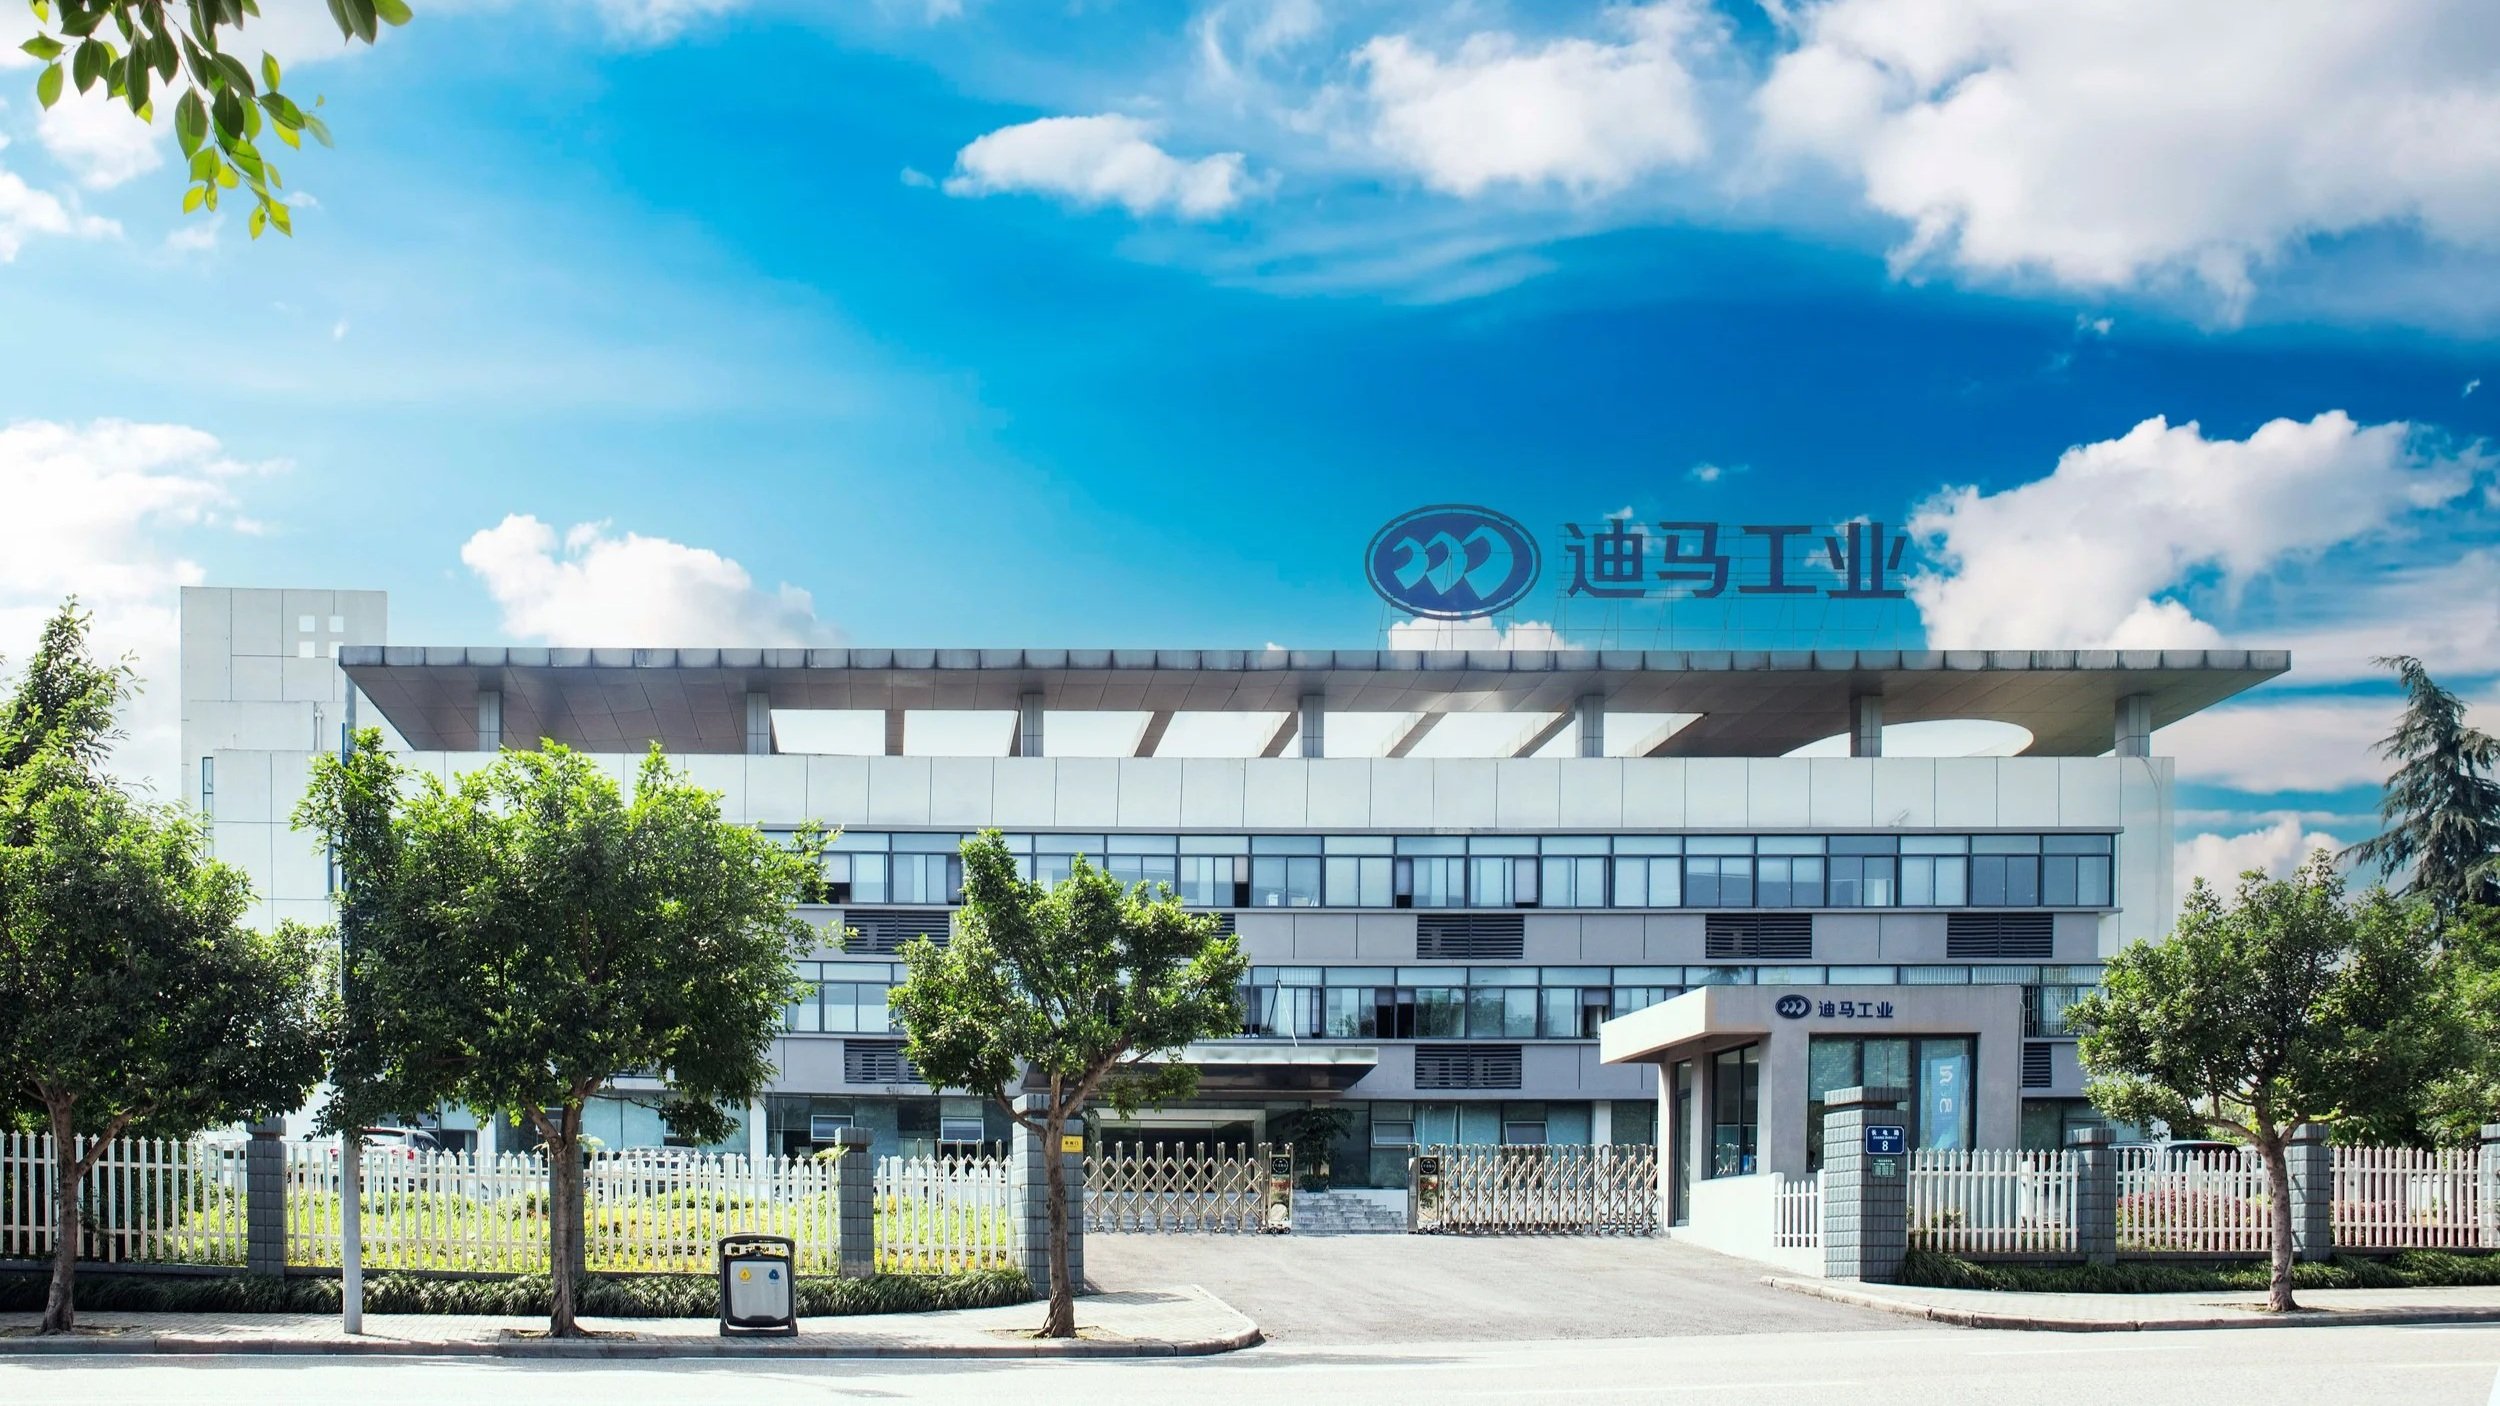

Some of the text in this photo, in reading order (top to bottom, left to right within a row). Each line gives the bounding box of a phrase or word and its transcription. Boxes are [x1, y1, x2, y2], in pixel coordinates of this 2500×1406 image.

[1565, 518, 1907, 598] 迪马工业
[1818, 1000, 1894, 1019] 迪马工业
[1882, 1140, 1889, 1151] 8
